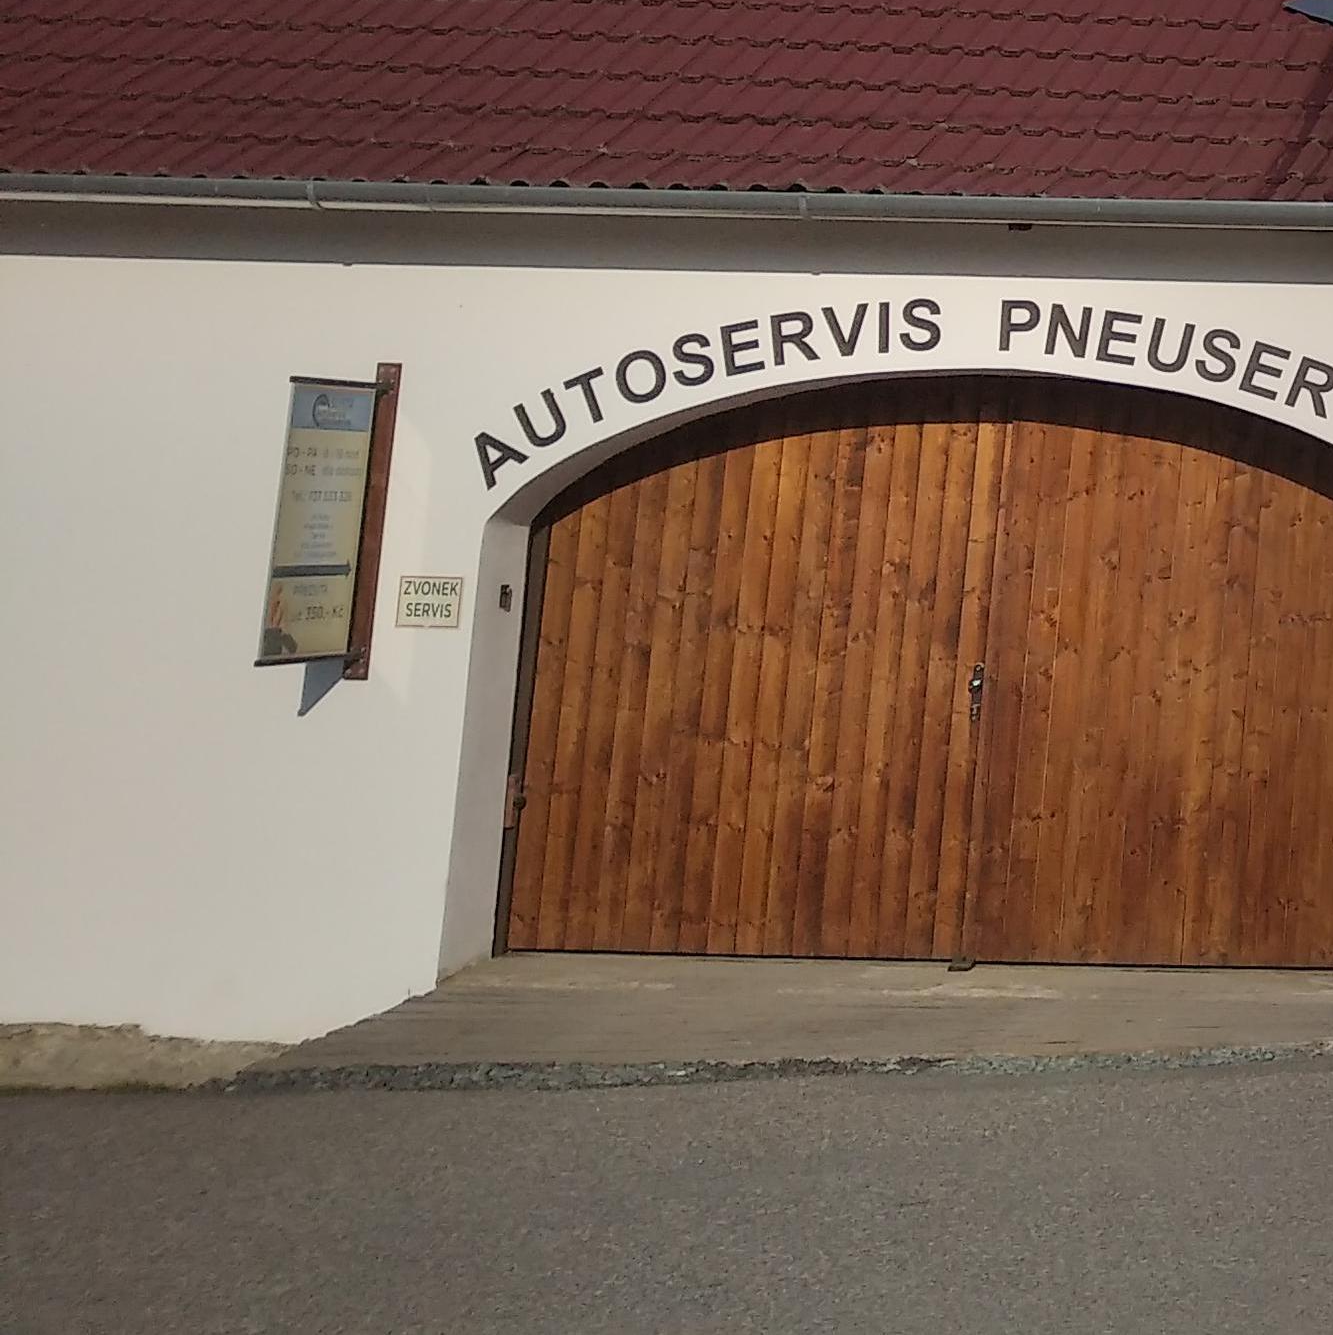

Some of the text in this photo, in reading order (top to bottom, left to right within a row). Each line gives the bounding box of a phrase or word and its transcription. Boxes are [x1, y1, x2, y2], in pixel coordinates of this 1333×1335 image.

[472, 297, 942, 491] AUTOSERVIS
[404, 581, 459, 596] ZVONEK
[406, 603, 452, 618] SERVIS
